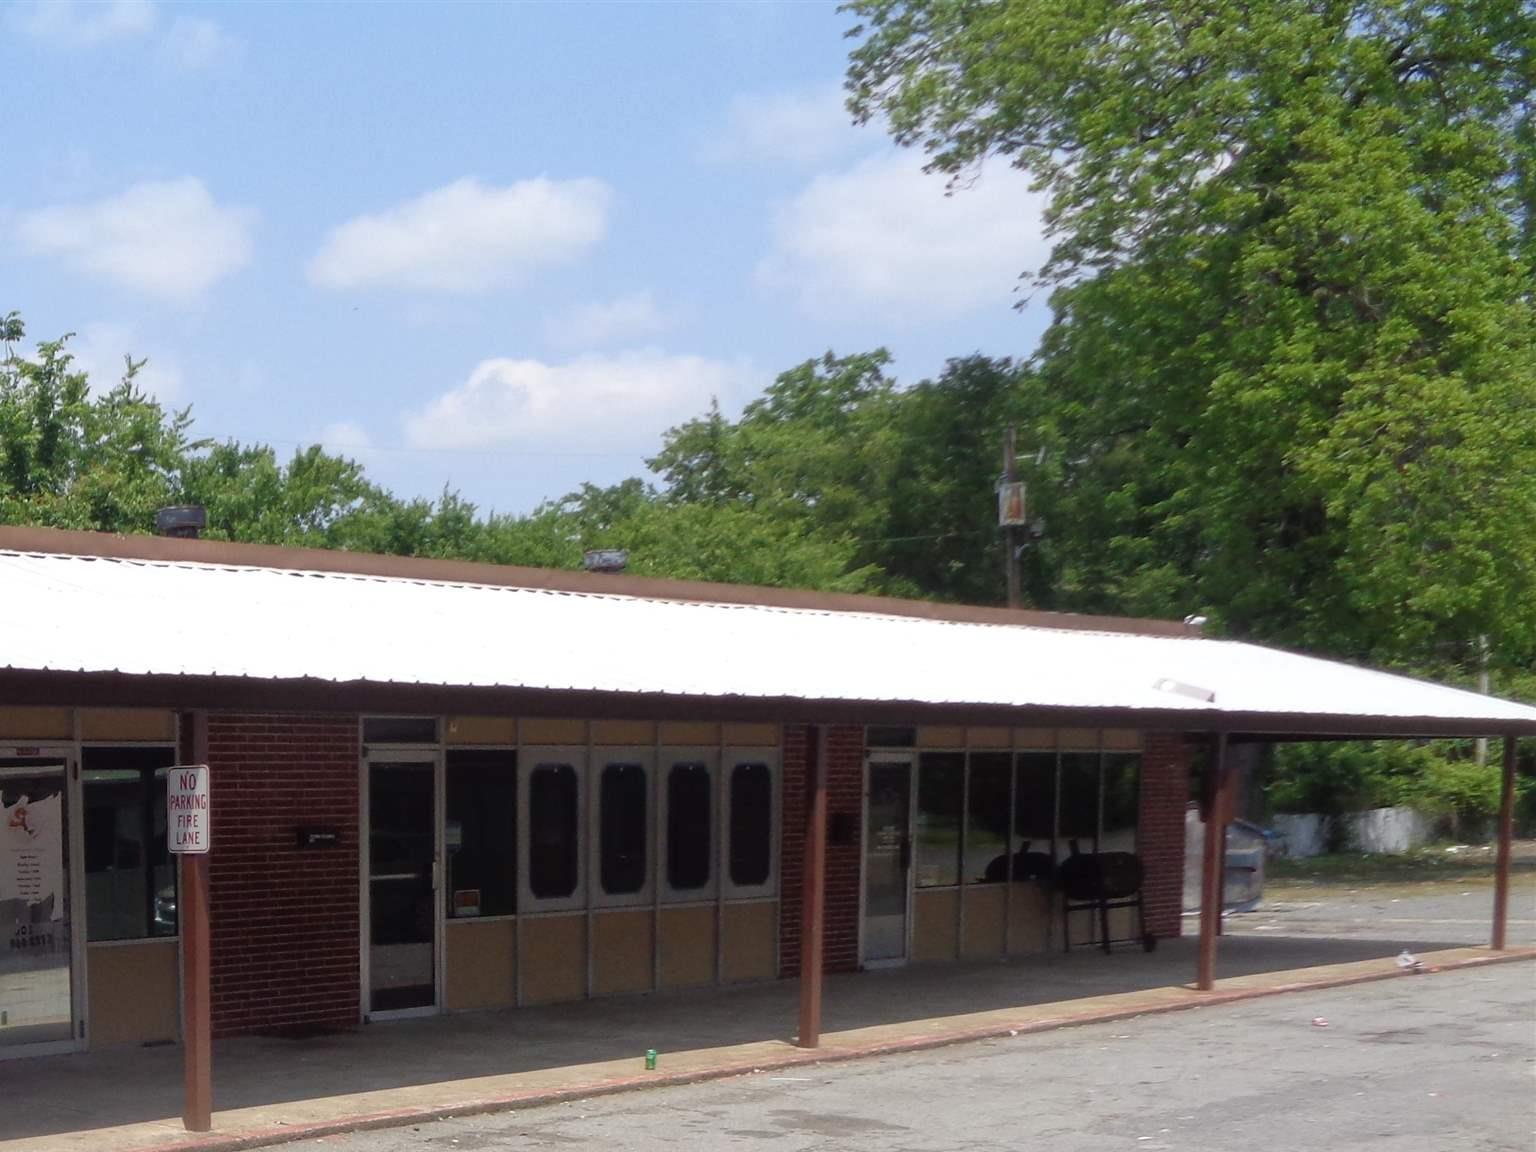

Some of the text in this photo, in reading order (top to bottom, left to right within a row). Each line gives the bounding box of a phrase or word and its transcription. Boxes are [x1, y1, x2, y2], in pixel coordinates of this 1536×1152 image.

[179, 773, 197, 790] NO
[170, 793, 207, 810] PARKING
[177, 814, 199, 829] FIRE
[176, 831, 201, 845] LANE
